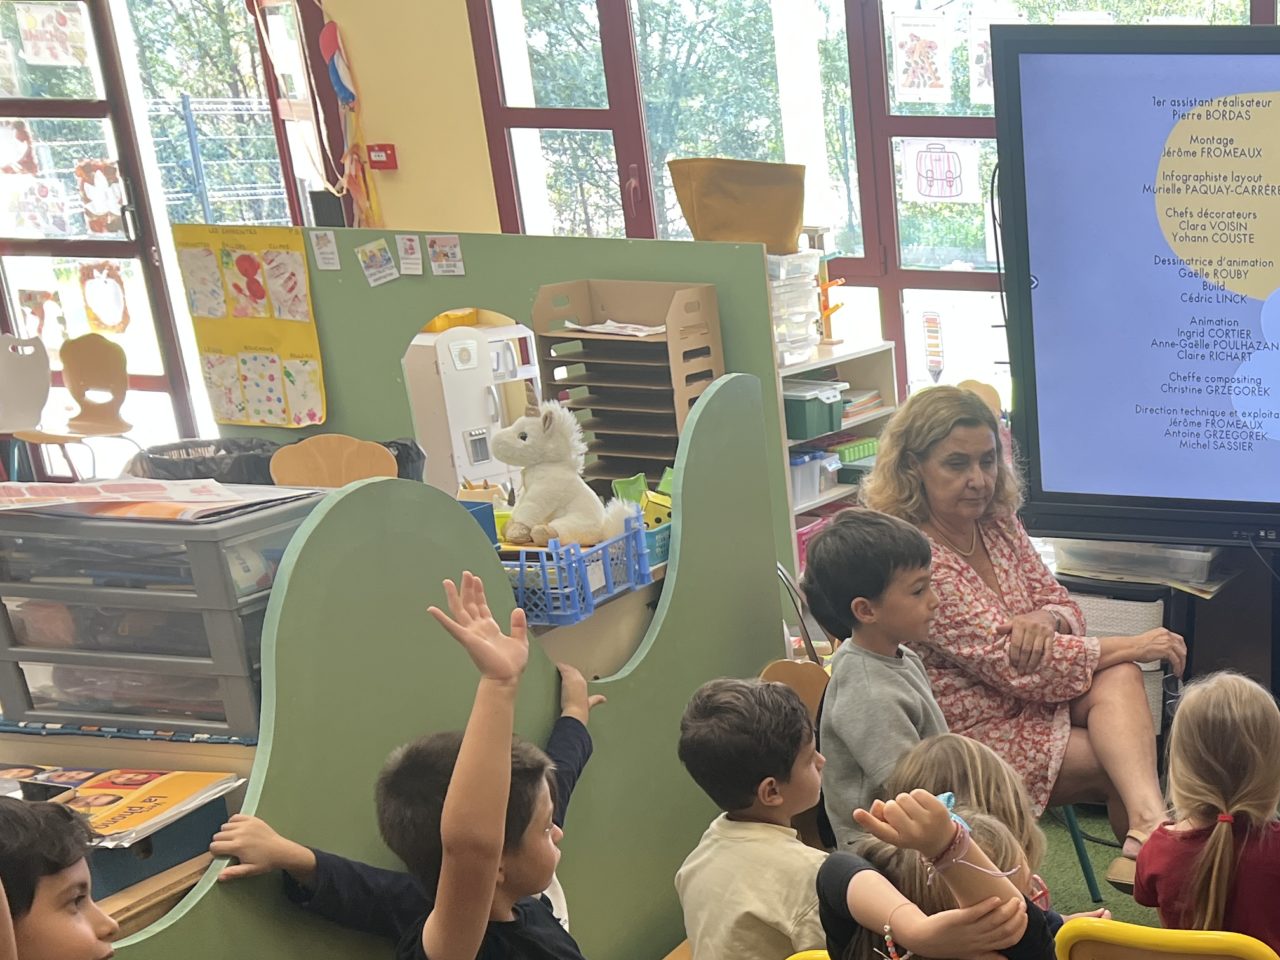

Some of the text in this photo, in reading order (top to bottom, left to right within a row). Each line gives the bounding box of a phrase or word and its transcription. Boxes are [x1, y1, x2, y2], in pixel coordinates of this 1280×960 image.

[1152, 96, 1272, 107] 1er assistant réalisateur
[1173, 109, 1251, 120] Pierre BORDAS
[1190, 135, 1234, 147] Montage
[1163, 146, 1262, 158] Jérôme FROMEAUX
[1163, 170, 1262, 186] Infographiste layout
[1143, 183, 1181, 194] Murielle
[1166, 207, 1257, 220] Chefs décorateurs
[1179, 220, 1247, 231] Clara VOISIN
[1172, 232, 1254, 243] Yohann COUSTE
[1155, 255, 1273, 267] Dessinatrice d'animation
[1179, 268, 1249, 279] Gaëlle ROUBY
[1203, 280, 1225, 291] Build
[1181, 293, 1247, 304] Cédric LINCK
[1190, 316, 1239, 326] Animation
[1178, 328, 1251, 341] Ingrid CORTIER
[1151, 338, 1209, 350] Anne-Gaëlle
[1177, 349, 1252, 362] Claire RICHART
[1205, 376, 1262, 389] compositing
[1161, 383, 1270, 396] Christine GRZEGOREK
[1136, 404, 1177, 415] Direction
[1181, 406, 1225, 419] technique
[1169, 418, 1263, 430] Jérôme FROMEAUX
[1165, 429, 1267, 441] Antoine GRZEGOREK
[1180, 439, 1253, 451] Michel SASSIER
